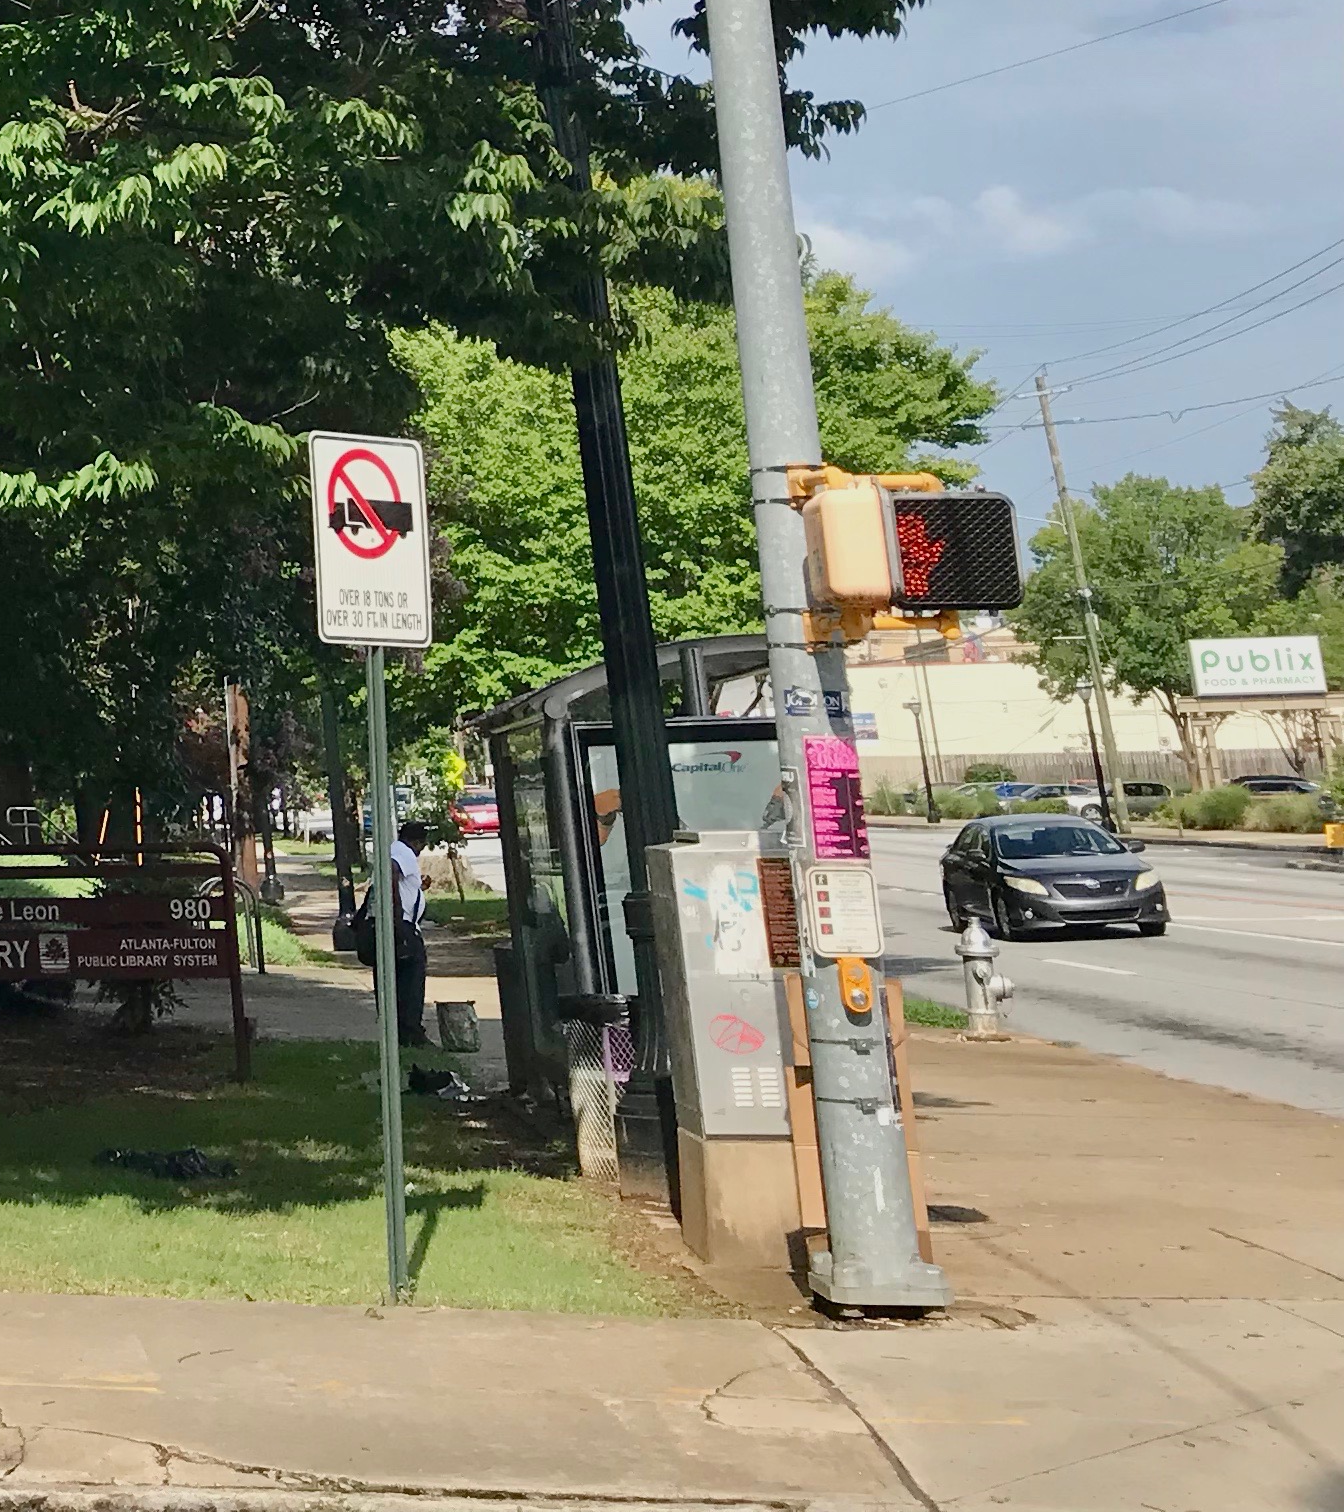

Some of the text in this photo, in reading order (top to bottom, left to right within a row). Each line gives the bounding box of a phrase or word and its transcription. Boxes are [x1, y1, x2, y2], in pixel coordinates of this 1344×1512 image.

[339, 588, 408, 609] OVER 18 TONS OR
[326, 609, 349, 626] OVER
[352, 610, 363, 628] 30
[379, 612, 388, 628] IN
[391, 613, 422, 630] LENGTH
[1199, 647, 1315, 673] Publix
[1204, 676, 1316, 687] FOOD & PHARMACY
[10, 900, 60, 921] Leon
[169, 898, 211, 920] 980
[119, 938, 217, 951] ATLANTA-FULTON
[77, 954, 218, 968] PUBLIC LIBRARY SYSTEM
